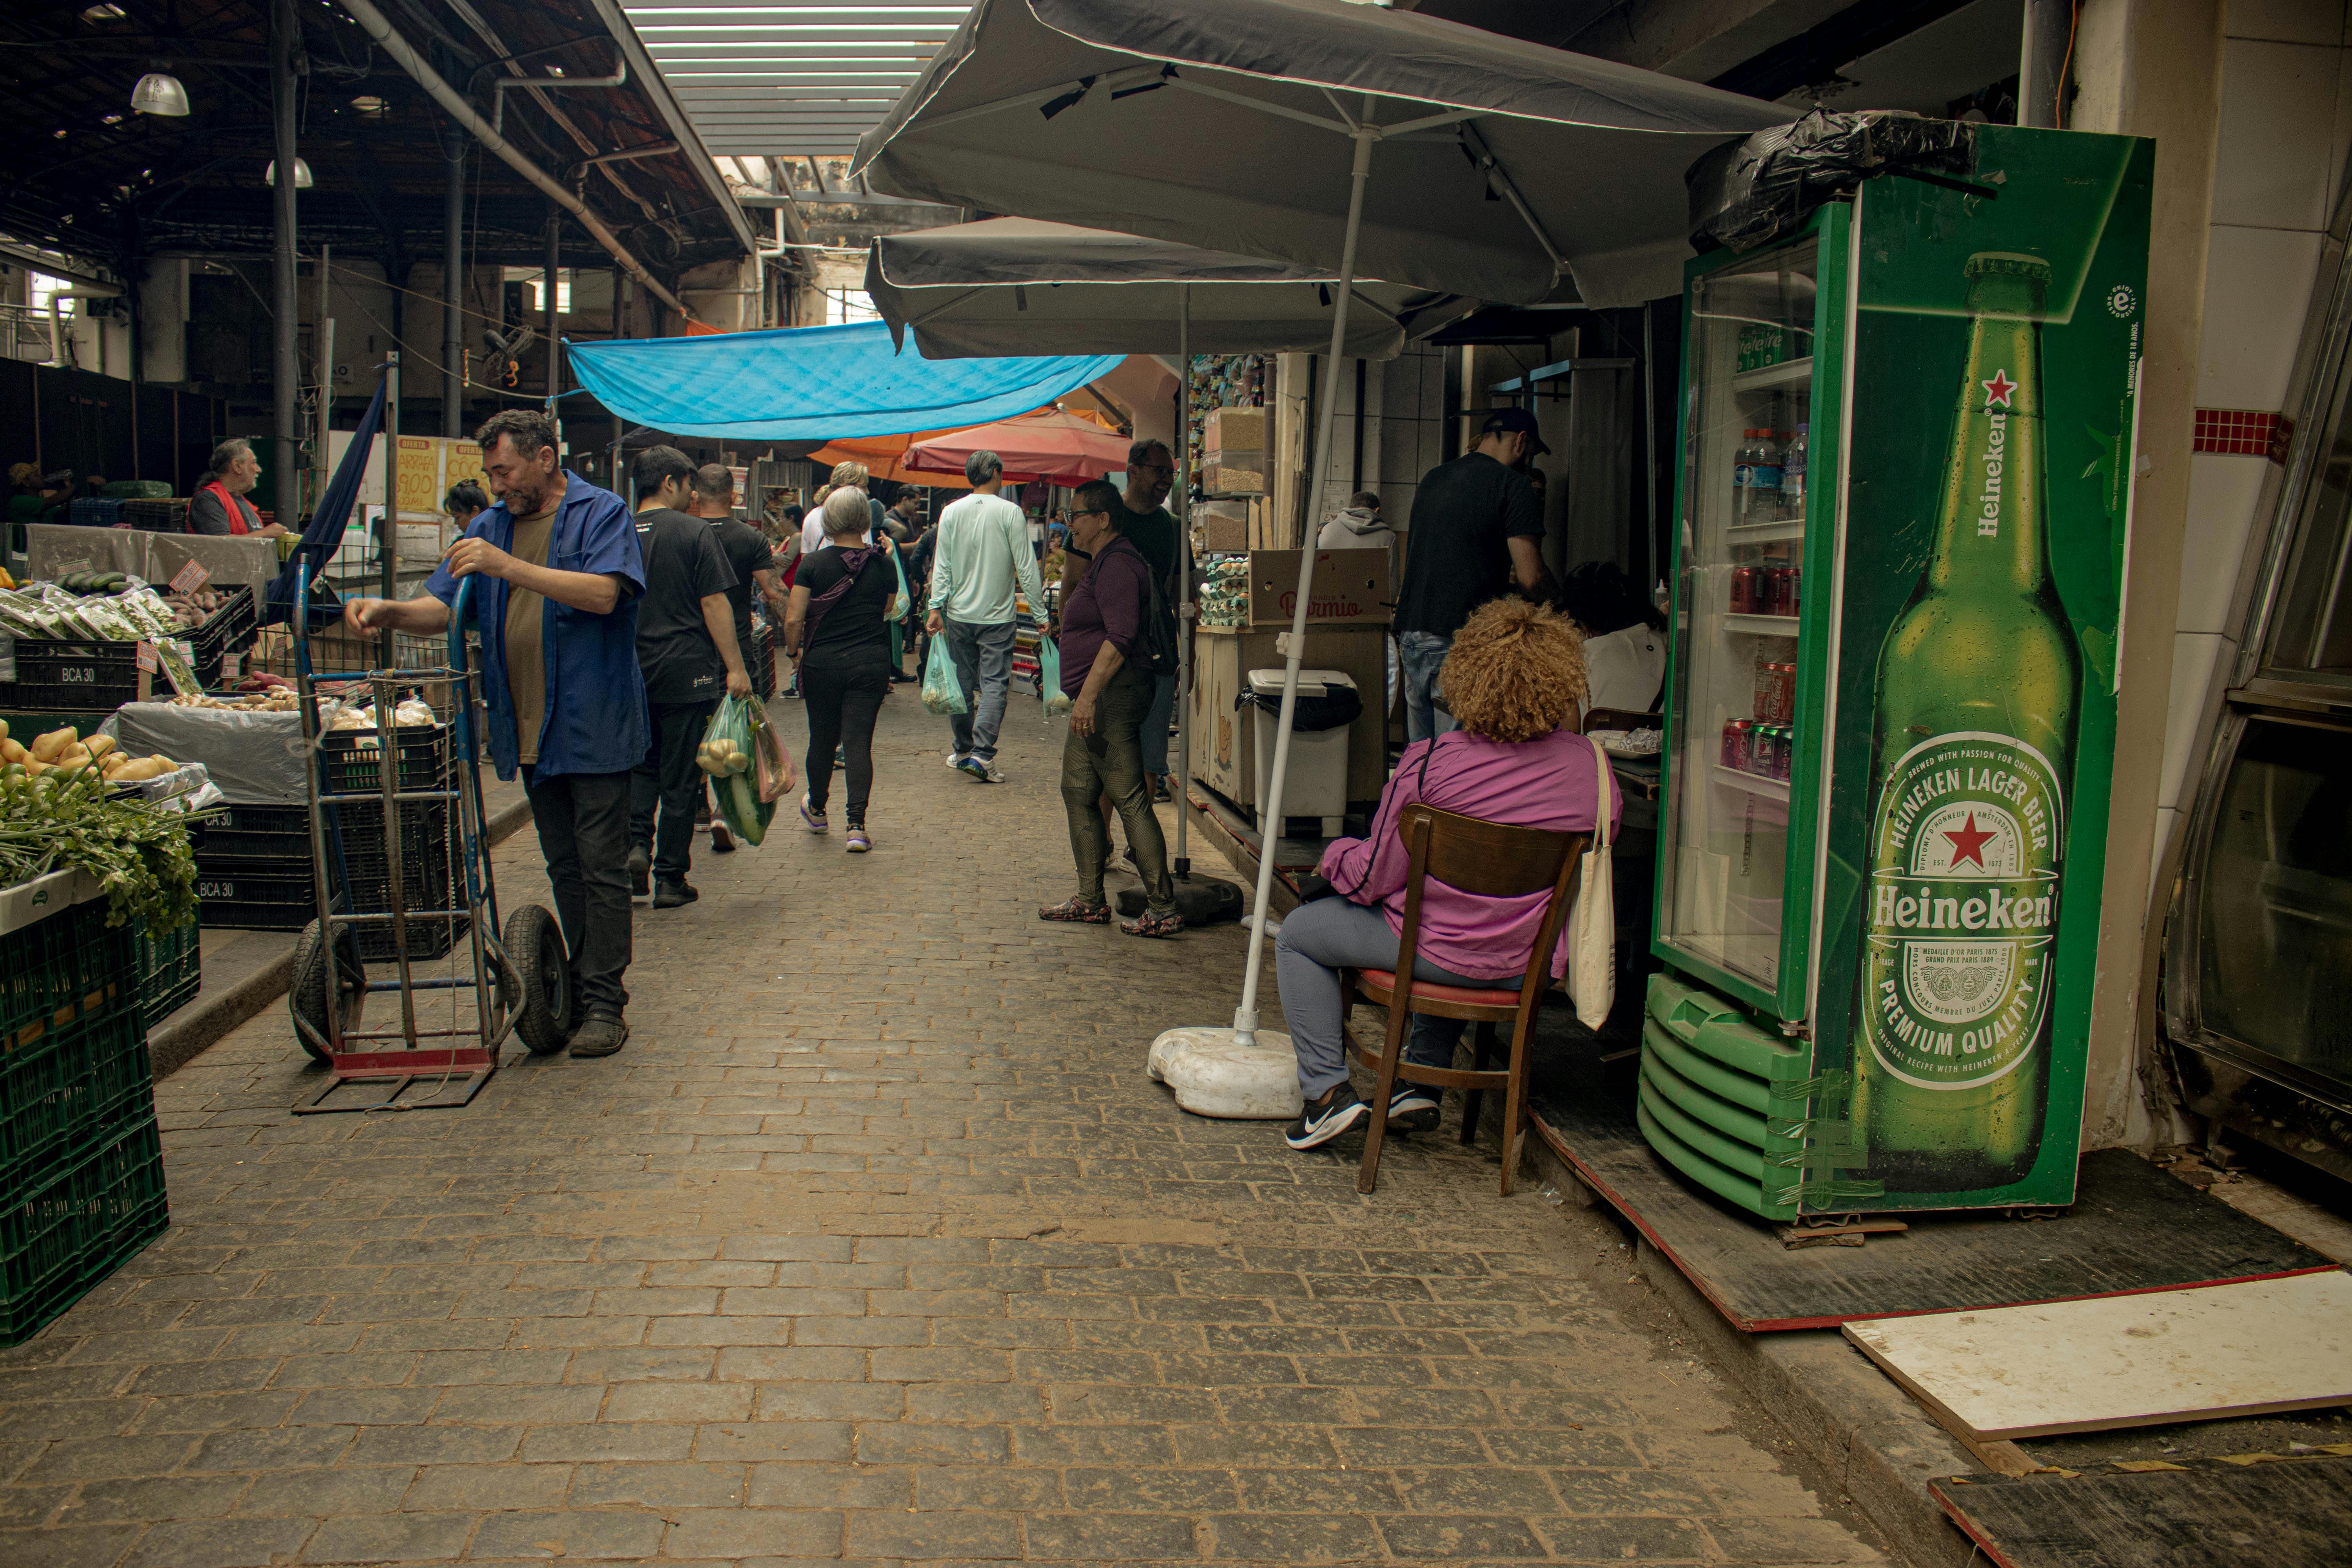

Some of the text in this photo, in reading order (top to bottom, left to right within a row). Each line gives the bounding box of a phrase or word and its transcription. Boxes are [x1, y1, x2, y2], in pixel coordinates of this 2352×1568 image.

[2130, 341, 2137, 350] 18
[2129, 351, 2136, 359] DE
[403, 439, 425, 449] OFERTA
[397, 454, 434, 472] ARRAFA
[62, 668, 94, 682] BCA 30
[1908, 750, 2040, 782] BREWED WITH PASSION FOR QUALITY
[1890, 767, 2047, 852] HEINEKEN LAGER BEER
[221, 811, 232, 826] 30
[1920, 836, 1931, 871] DIPLOME
[1929, 810, 1965, 835] D'HONNEUR
[1977, 811, 2012, 837] AMSTERDAM
[2008, 839, 2014, 849] EN
[200, 882, 233, 897] BCA 30
[1879, 958, 1895, 966] TRADE
[2024, 958, 2038, 966] MARK
[1912, 971, 1933, 1009] CONCOURS
[1934, 1005, 1963, 1016] MEMBRE
[1966, 1006, 1976, 1014] DU
[1979, 994, 1994, 1009] JURY
[1994, 970, 2005, 993] PARIS
[1879, 978, 2034, 1056] PREMIUM QUALITY
[1877, 1026, 2030, 1073] ORIGINAL RECIPE WITH HEINEKEN A-YEAST
